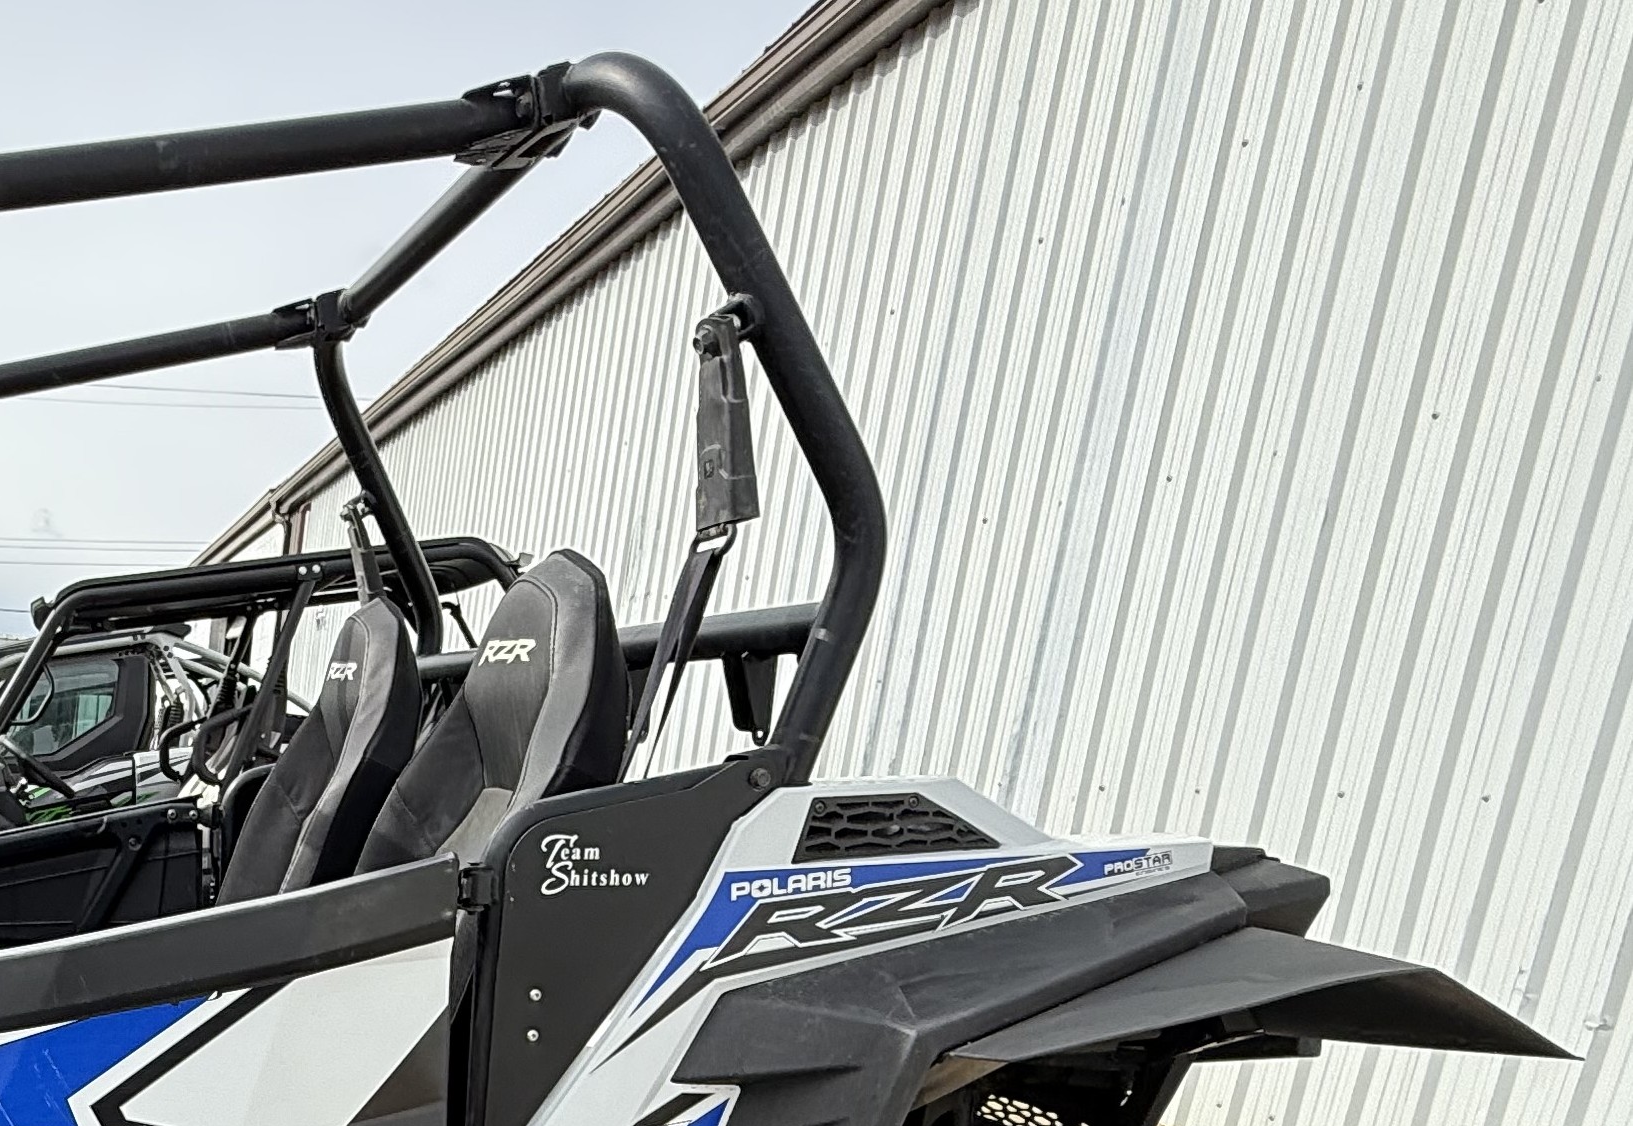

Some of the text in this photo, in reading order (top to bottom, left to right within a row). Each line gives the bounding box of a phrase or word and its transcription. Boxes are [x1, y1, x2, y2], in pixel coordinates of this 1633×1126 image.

[478, 638, 536, 667] RZR
[327, 662, 357, 681] RZR
[541, 834, 600, 868] Team
[1103, 851, 1173, 876] PROSTAR
[541, 861, 650, 895] Shitshow
[730, 867, 852, 902] POLARIS
[703, 852, 1084, 972] RZR
